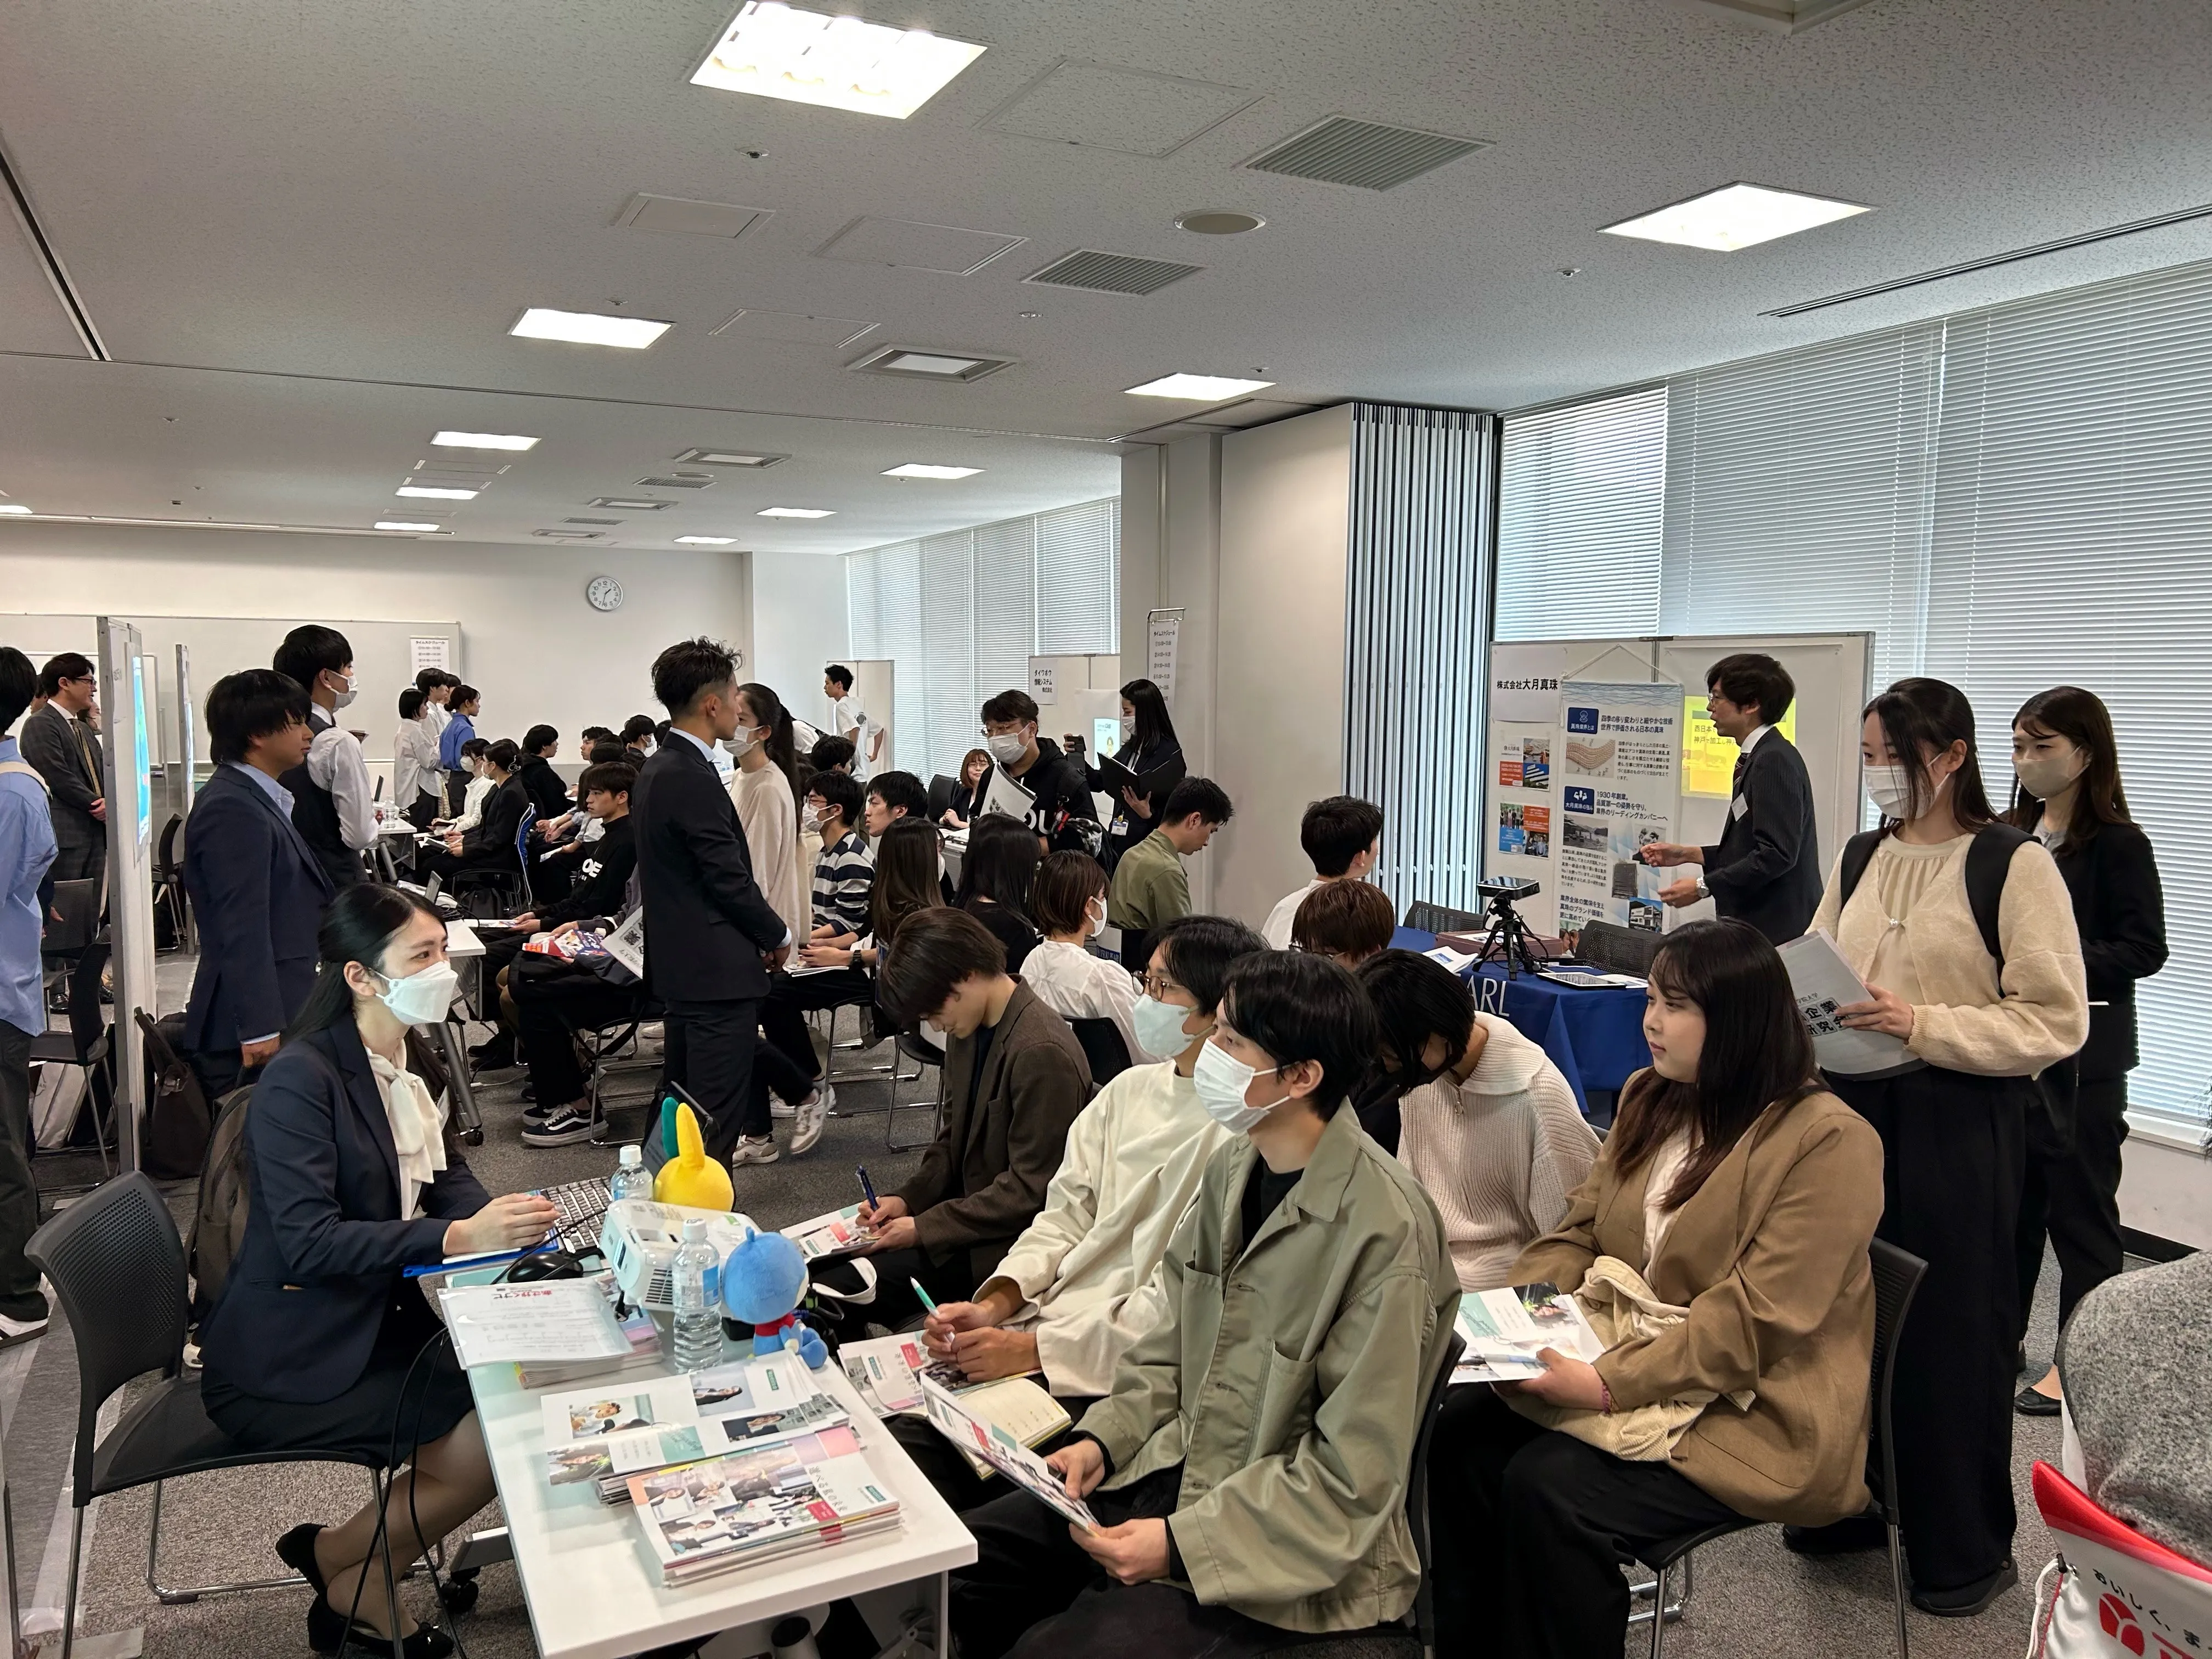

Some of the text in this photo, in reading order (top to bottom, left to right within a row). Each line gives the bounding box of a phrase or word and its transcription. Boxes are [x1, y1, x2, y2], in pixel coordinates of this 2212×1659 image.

[1497, 678, 1558, 690] 株式会社大月真珠
[1601, 724, 1664, 733] 世界で評価される日本の真珠
[1596, 799, 1647, 811] 品質第一の姿勢を守り、
[1596, 808, 1668, 821] 業界のリーディングカンパニーへ
